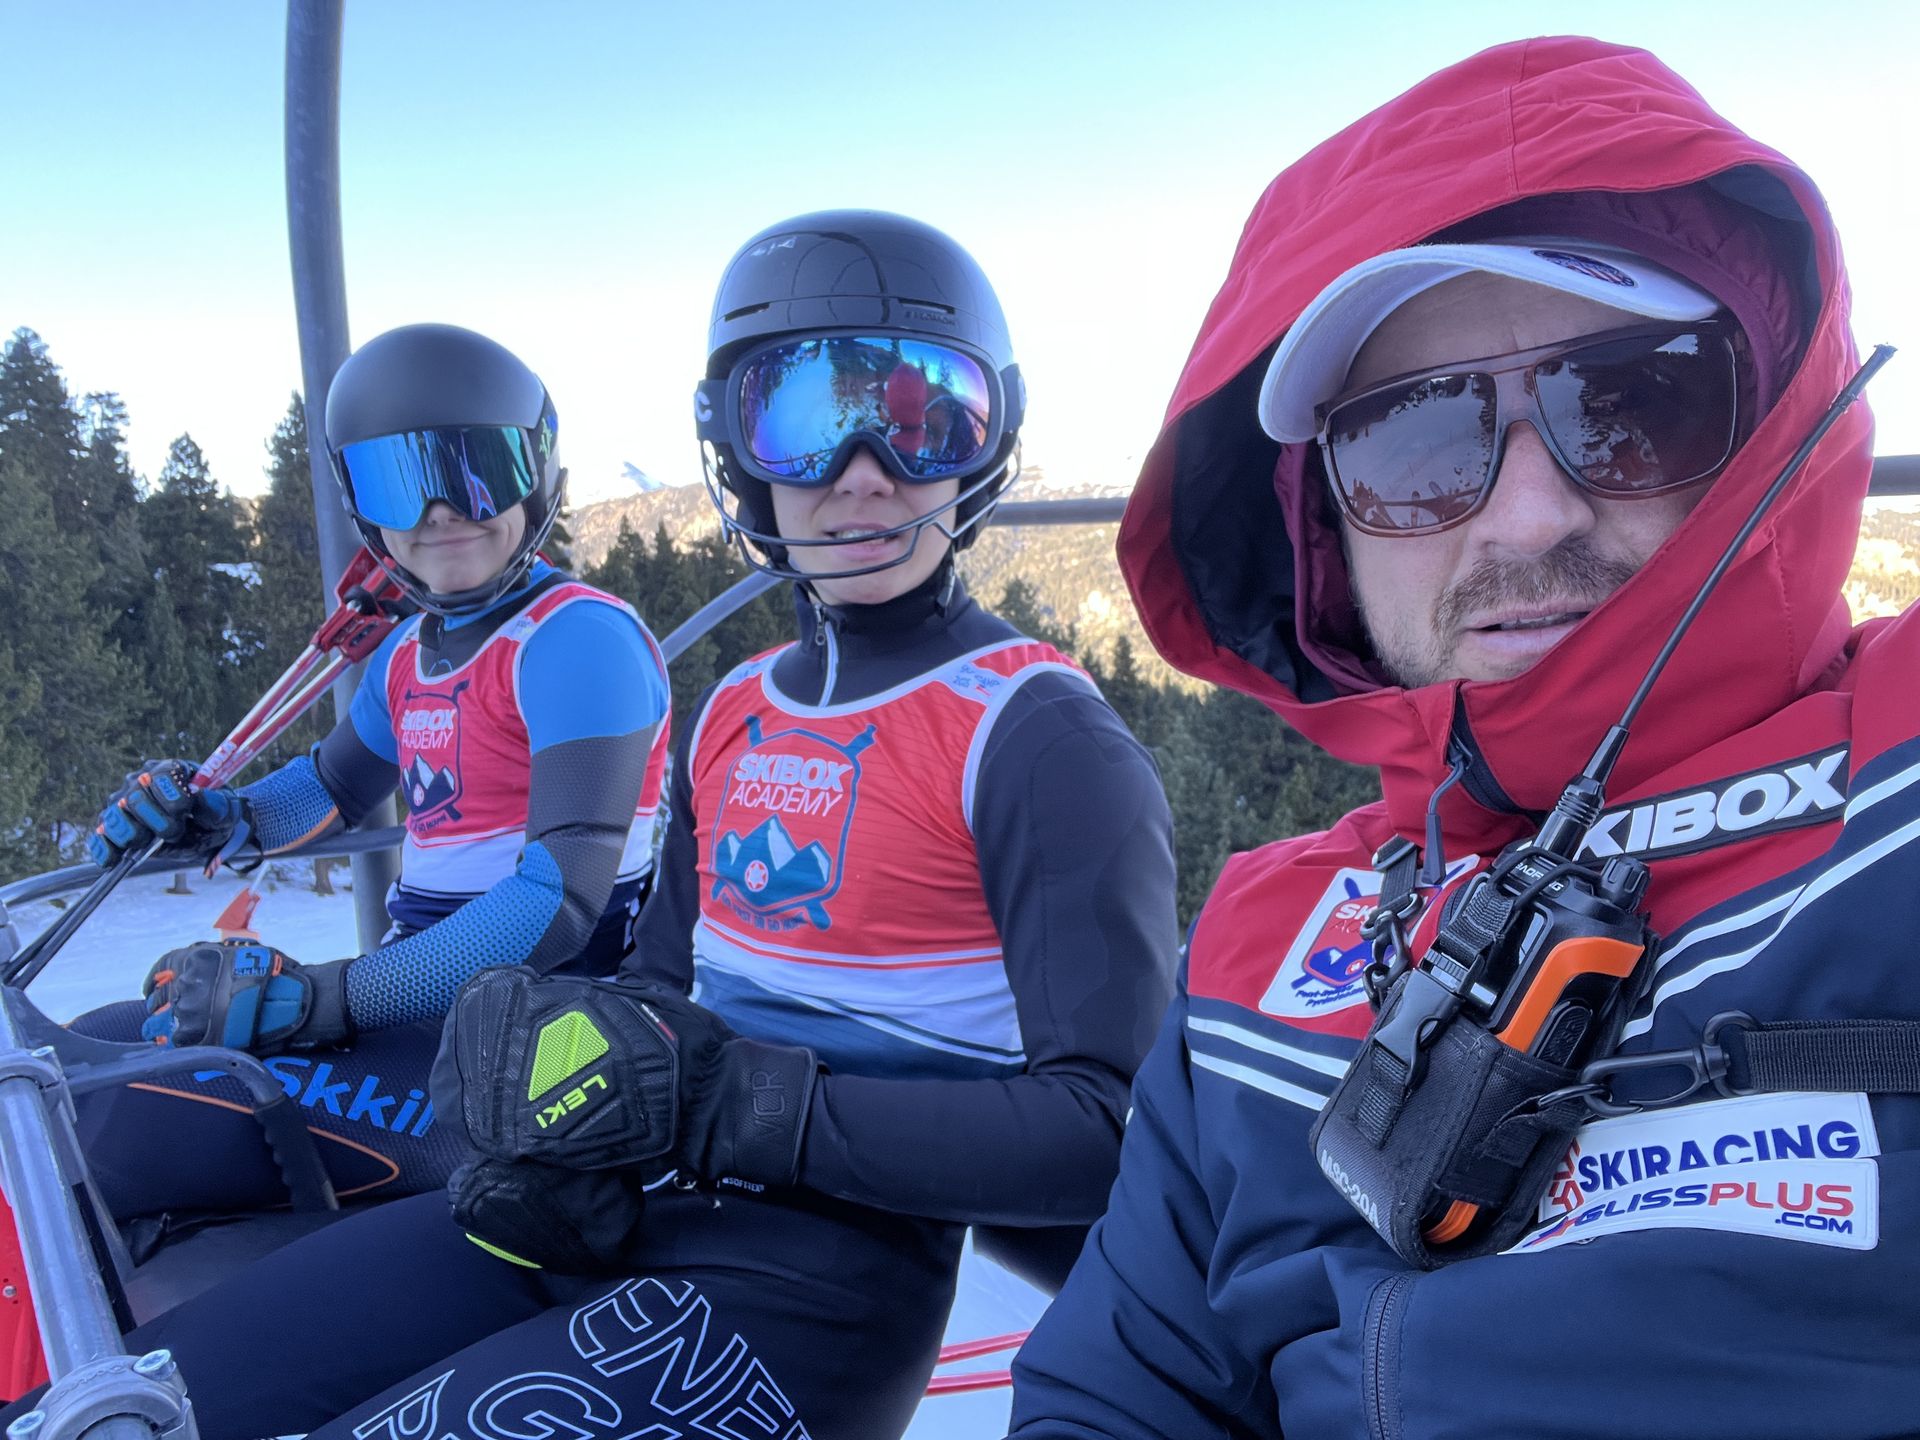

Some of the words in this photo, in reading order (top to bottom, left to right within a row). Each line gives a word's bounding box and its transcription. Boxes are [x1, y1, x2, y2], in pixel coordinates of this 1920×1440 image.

[734, 752, 854, 793] SKIBOX
[728, 781, 844, 817] ACADEMY
[1572, 750, 1848, 862] KIBOX
[535, 1074, 608, 1129] LEKI
[1577, 1120, 1862, 1193] SKIRACING
[1573, 1181, 1855, 1228] GLISSPLUS
[1774, 1212, 1854, 1235] .COM
